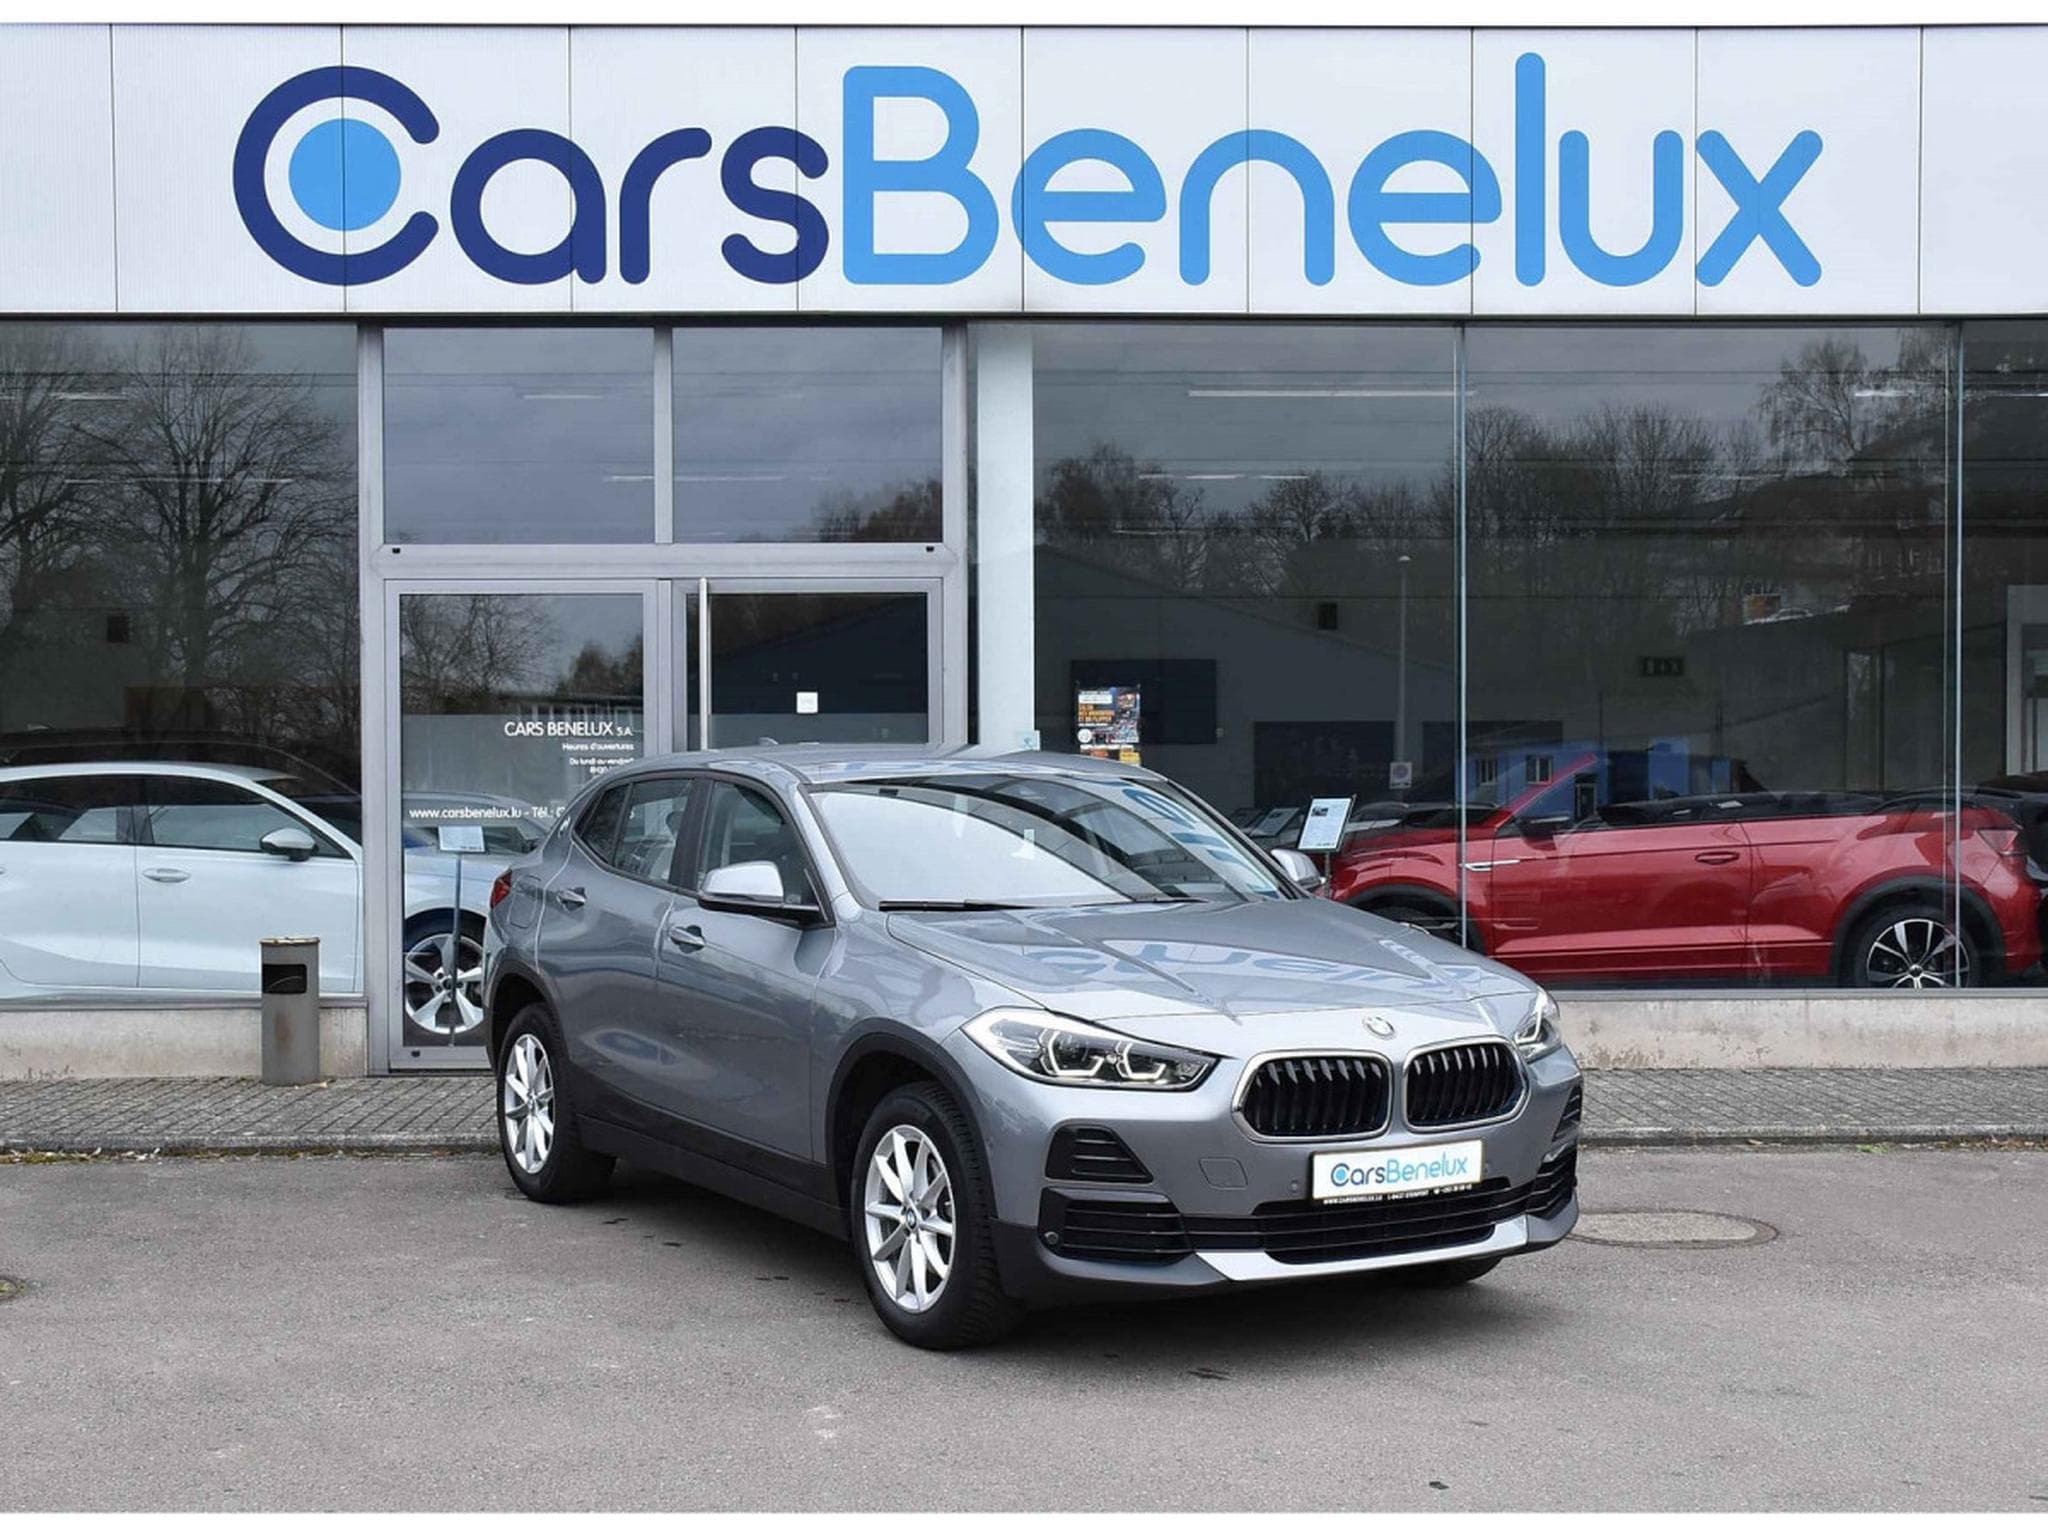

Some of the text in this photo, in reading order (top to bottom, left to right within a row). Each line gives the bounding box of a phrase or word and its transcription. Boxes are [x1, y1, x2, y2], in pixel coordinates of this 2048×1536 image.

[232, 52, 1823, 286] CarsBenelux
[504, 721, 544, 737] CARS
[547, 721, 613, 737] BENELUX
[409, 806, 522, 818] www.carsbenelux.lu
[1330, 1151, 1468, 1187] CarsBenelux
